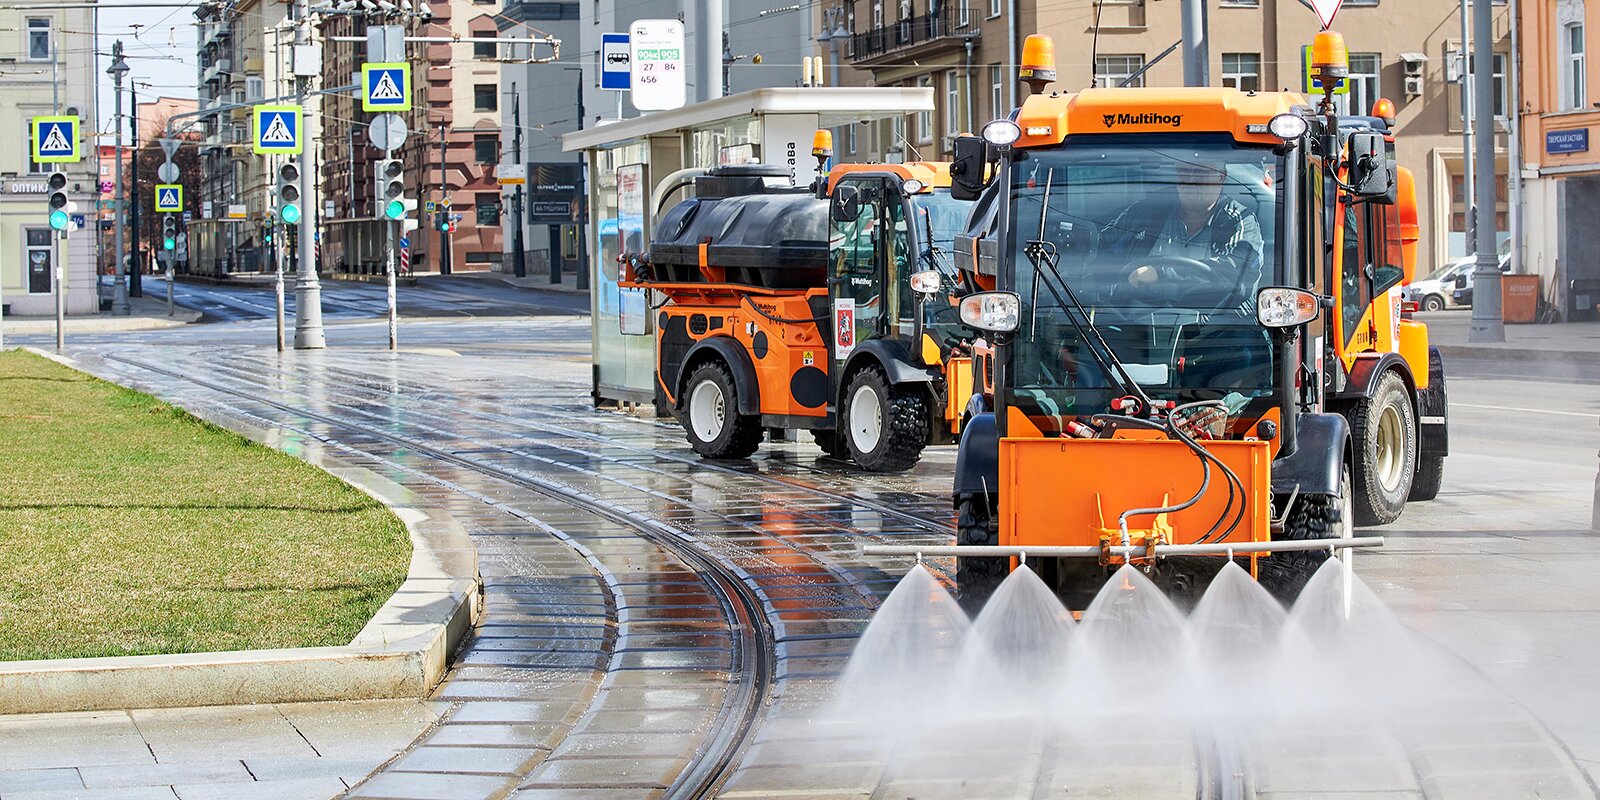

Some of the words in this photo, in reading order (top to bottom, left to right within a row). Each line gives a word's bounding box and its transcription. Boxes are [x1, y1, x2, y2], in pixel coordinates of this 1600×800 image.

[661, 50, 679, 60] 905
[643, 63, 654, 71] 27
[664, 63, 676, 71] 84
[1117, 113, 1181, 127] Multihog
